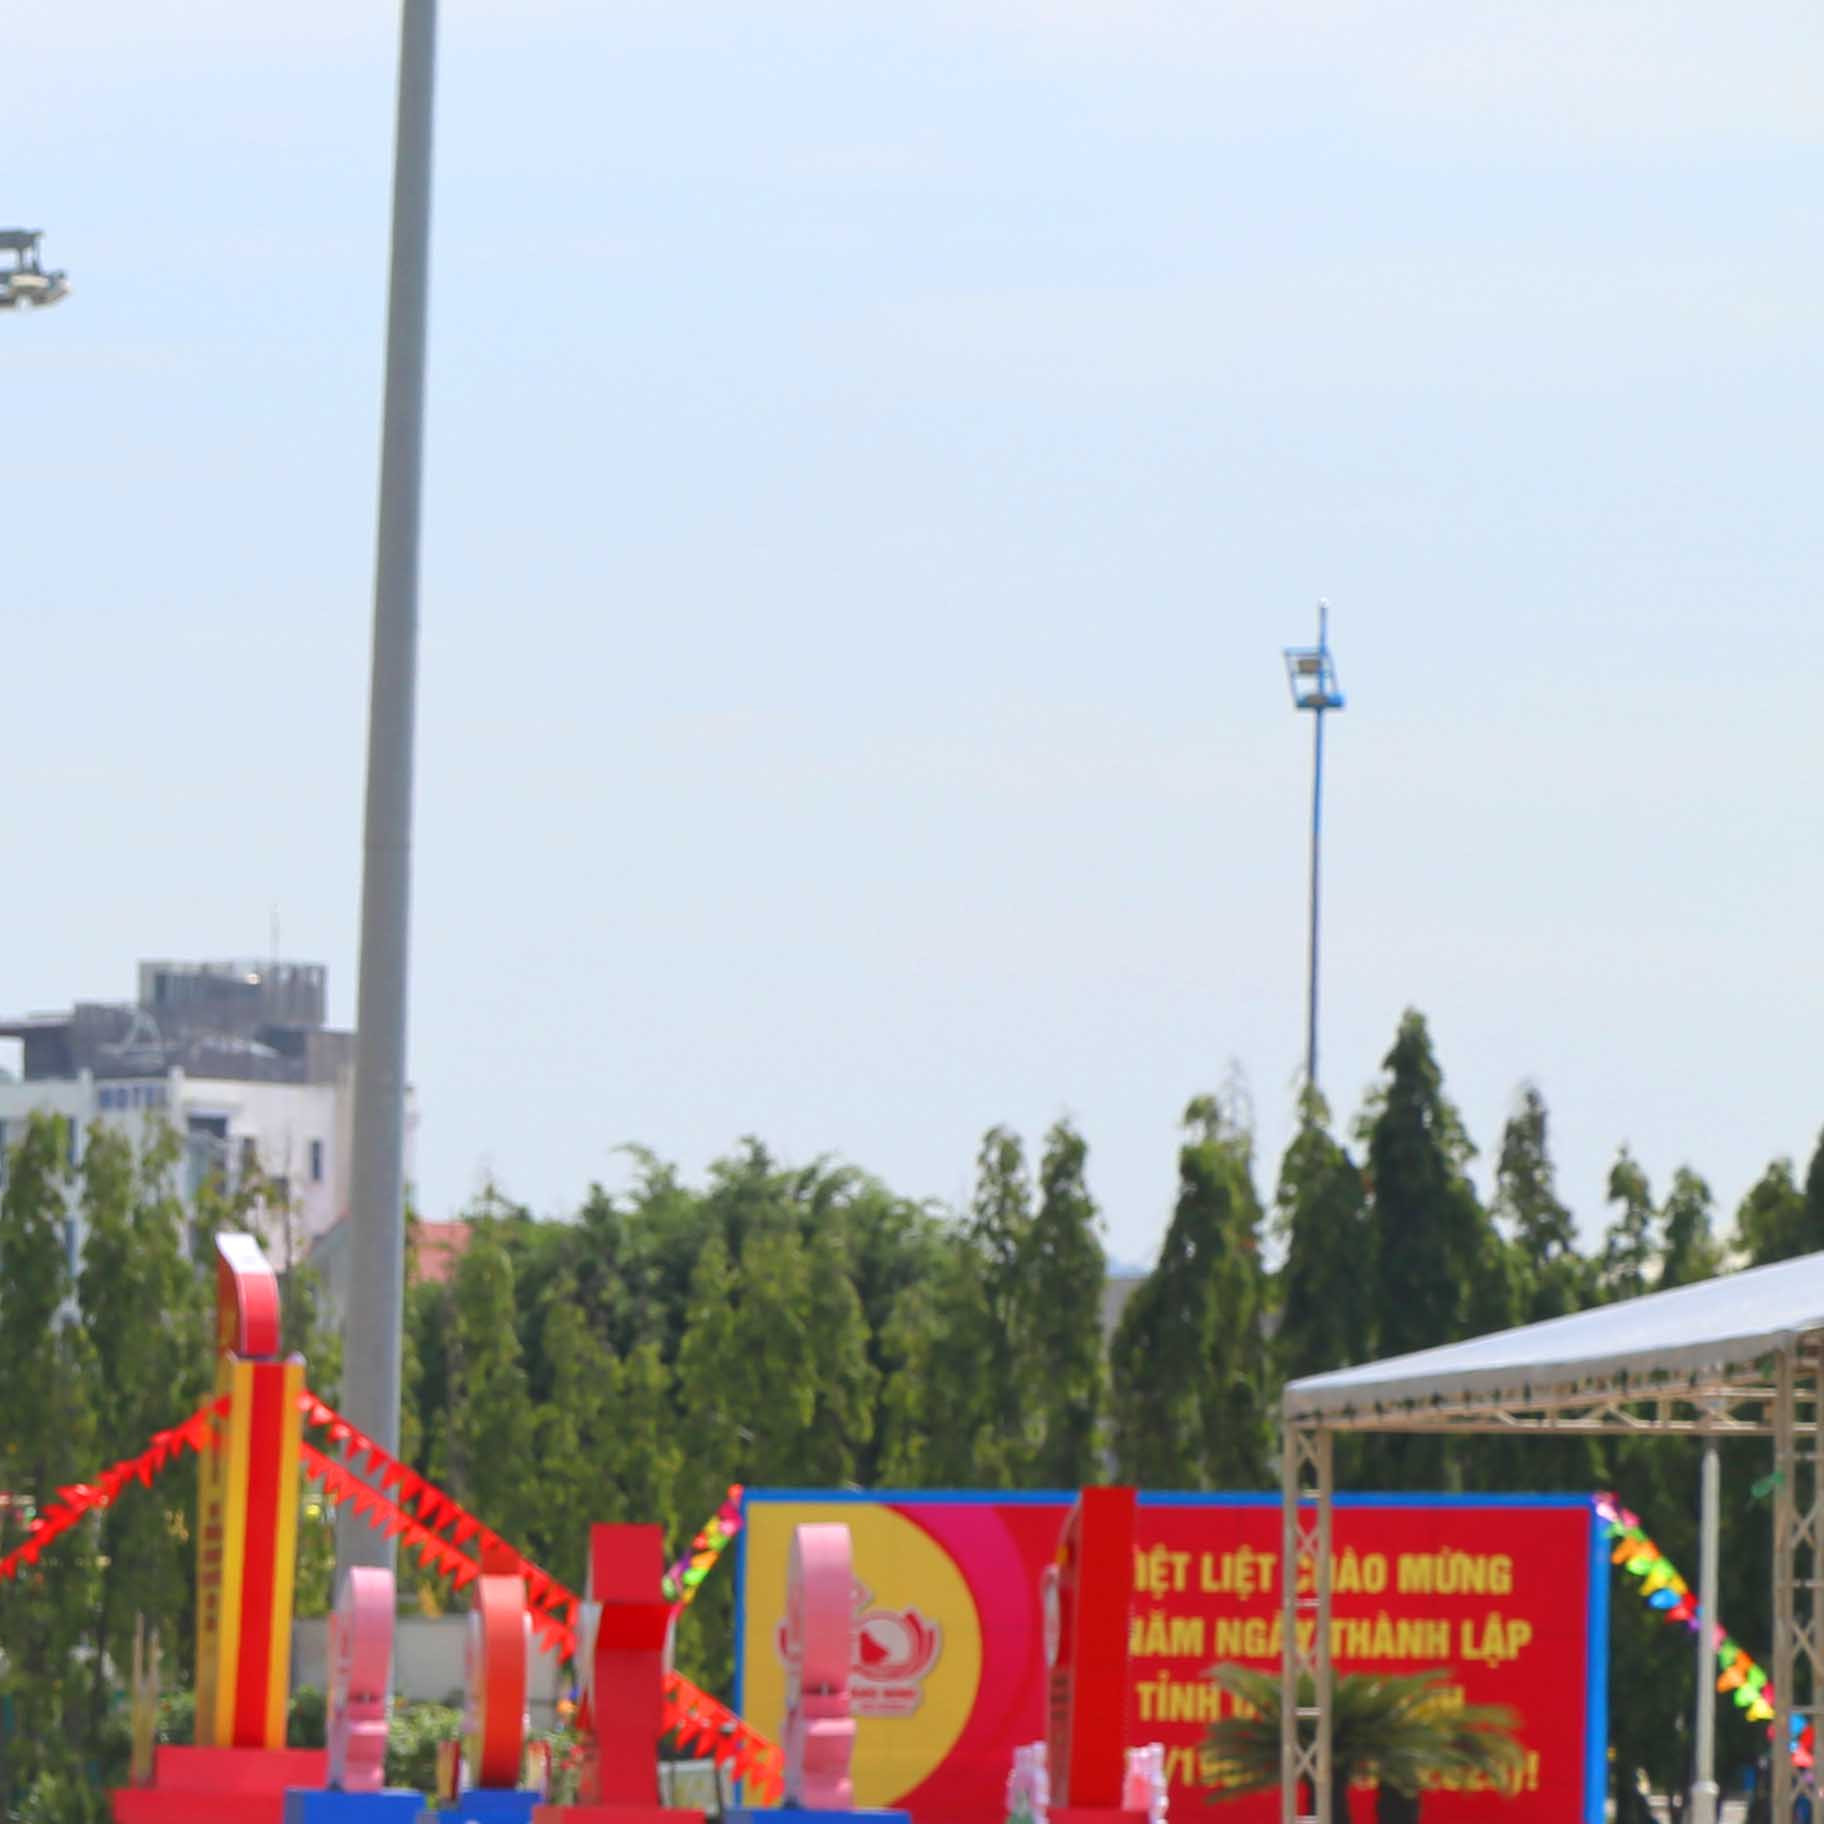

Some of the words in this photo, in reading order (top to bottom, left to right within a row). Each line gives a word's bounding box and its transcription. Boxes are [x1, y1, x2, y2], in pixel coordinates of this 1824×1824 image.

[1201, 1543, 1277, 1601] LIỆT
[1397, 1543, 1513, 1596] MỪNG
[1330, 1608, 1450, 1660] THÀNH
[1459, 1609, 1532, 1670] LẬP
[1135, 1669, 1220, 1723] TỈNH
